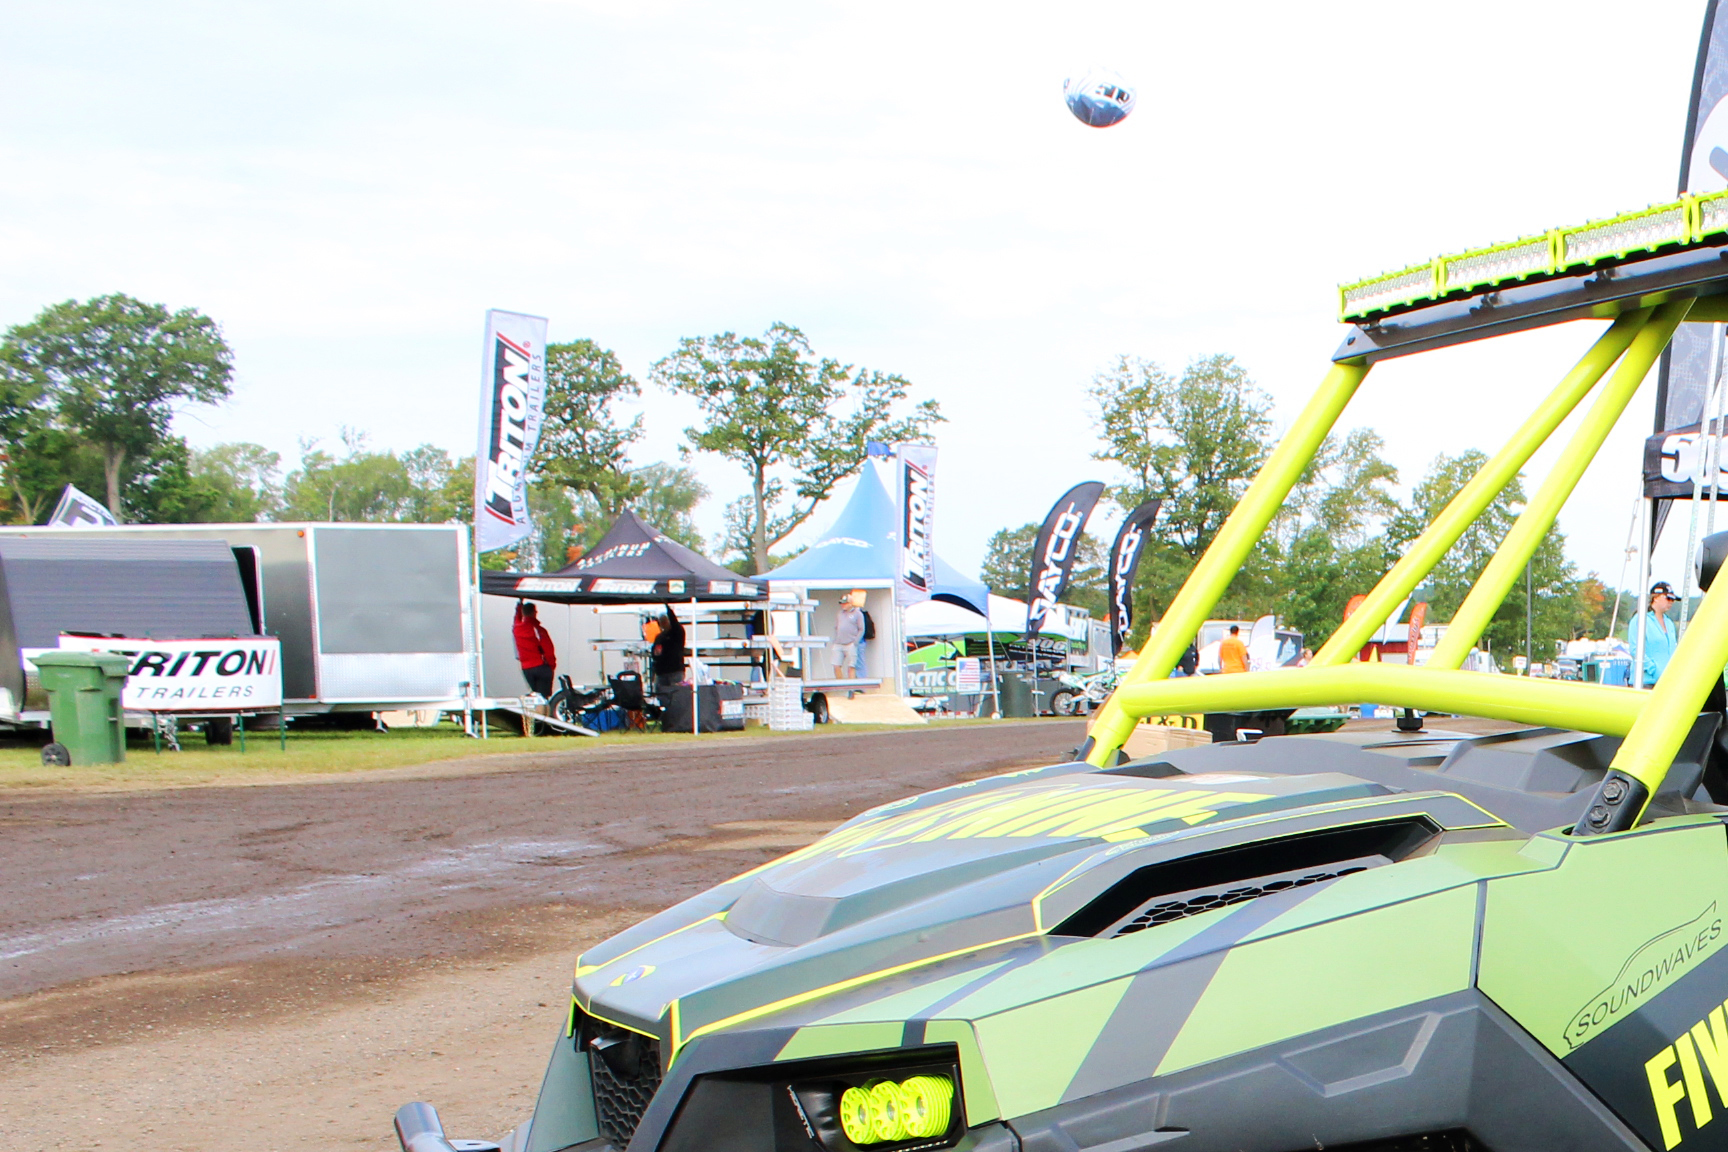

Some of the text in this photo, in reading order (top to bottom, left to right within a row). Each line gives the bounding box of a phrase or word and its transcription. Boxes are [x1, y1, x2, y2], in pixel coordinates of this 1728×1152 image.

[484, 345, 531, 504] TRITON
[528, 353, 543, 432] TRAILERS
[903, 469, 929, 579] TRITON
[1029, 508, 1081, 622] DAYCO
[137, 685, 254, 698] TRAILERS
[906, 671, 946, 687] RCTIC
[1575, 918, 1722, 1037] SOUNDWAVES
